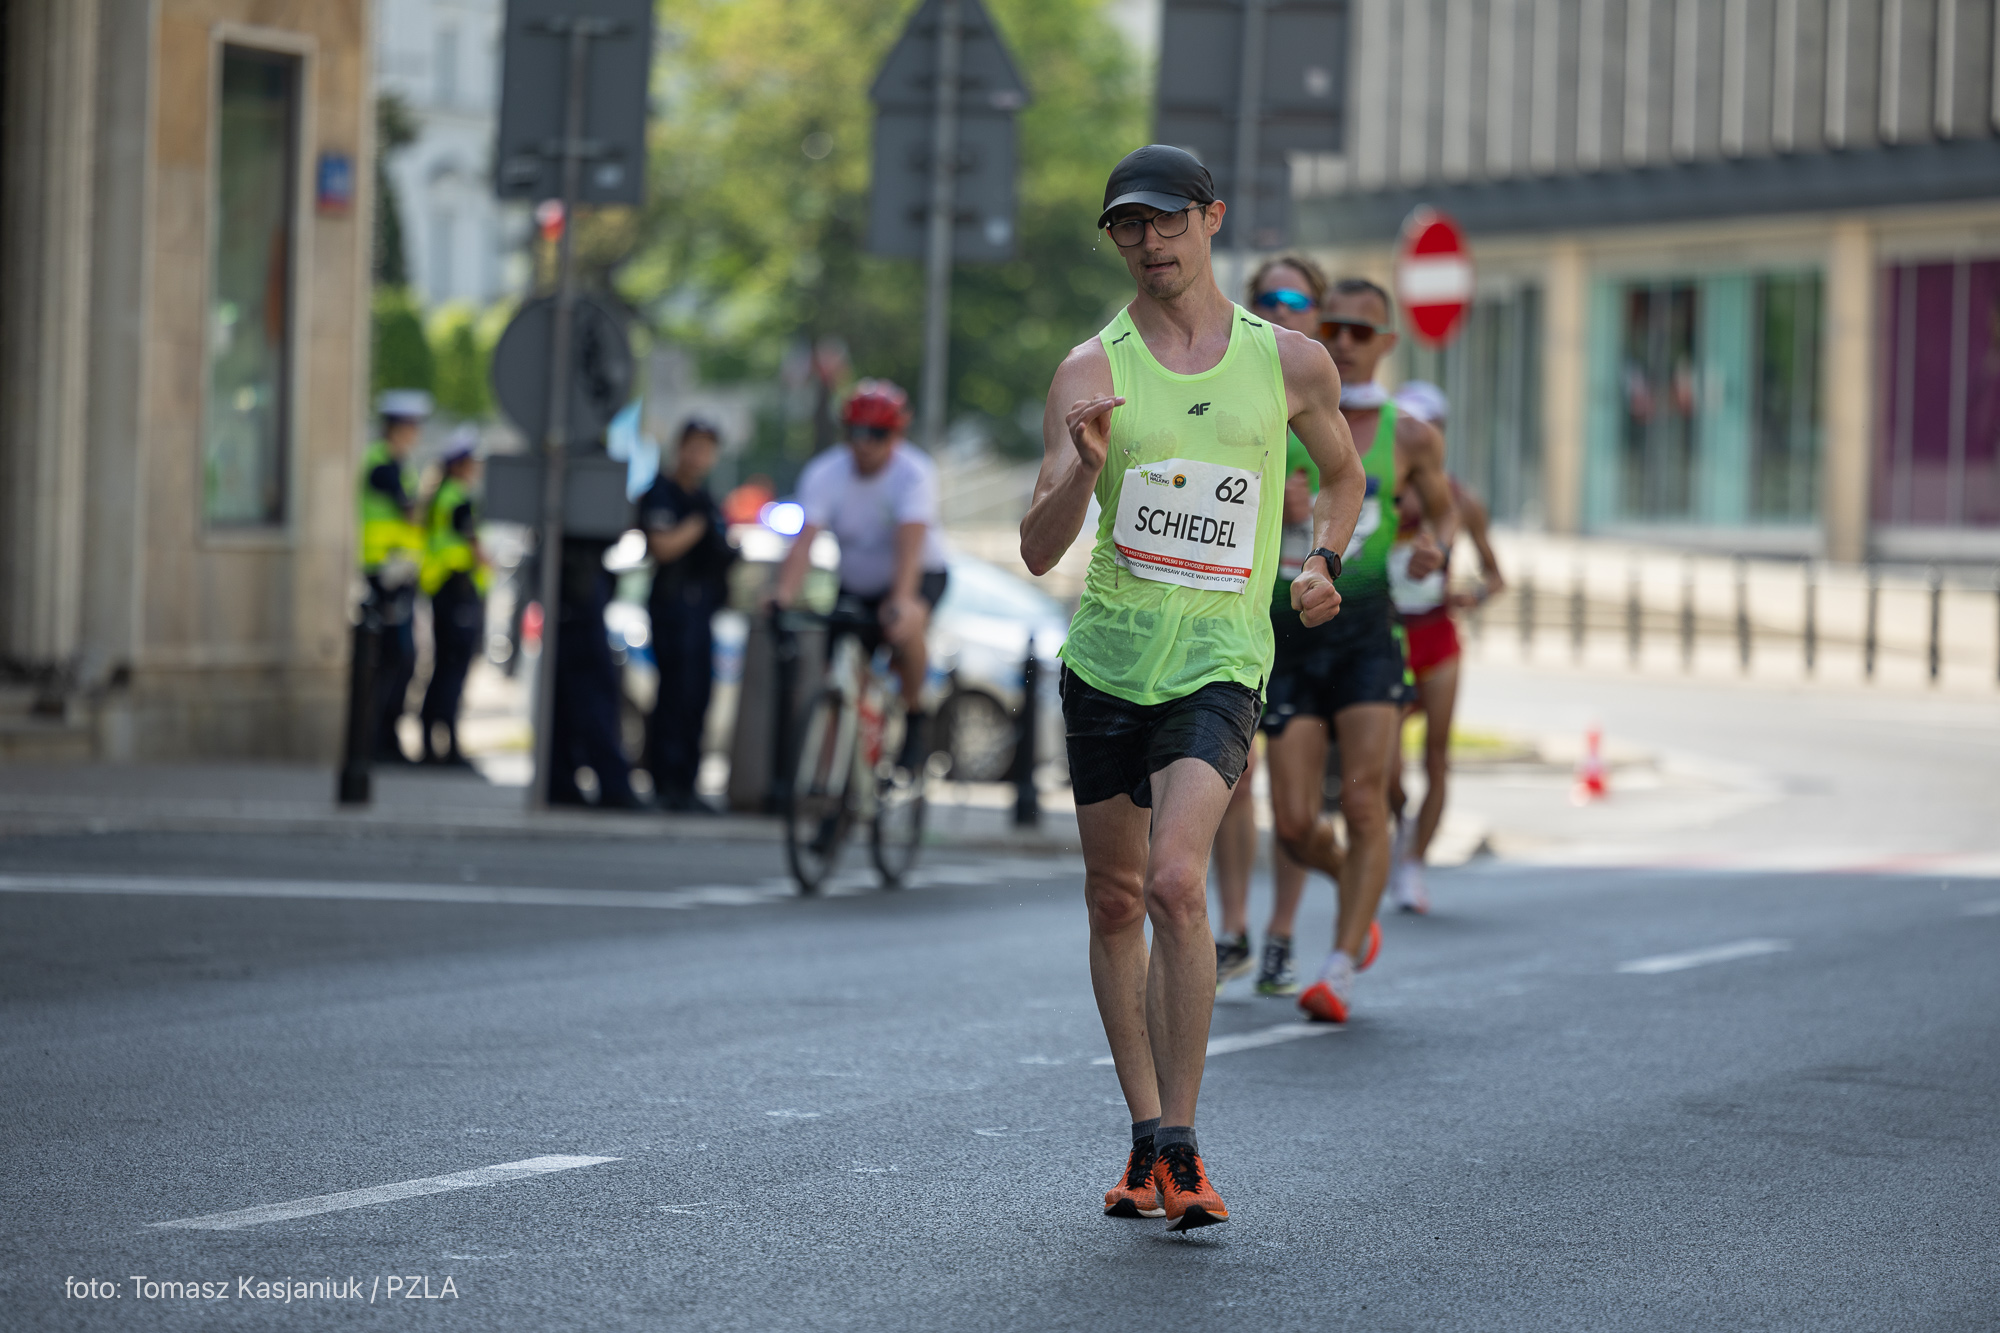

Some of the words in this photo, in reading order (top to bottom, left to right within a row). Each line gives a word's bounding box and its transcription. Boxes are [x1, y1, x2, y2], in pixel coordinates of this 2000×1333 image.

[1187, 402, 1211, 416] 4F
[1150, 476, 1170, 485] WALKING
[1215, 477, 1248, 504] 62
[1134, 506, 1236, 548] SCHIEDEL
[1128, 549, 1161, 562] MISTRZOSTWA
[1161, 557, 1178, 566] POLSKI
[1184, 561, 1205, 570] CHODZIE
[1204, 565, 1233, 573] SPORTOWYM
[1154, 565, 1181, 575] WARSAW
[1180, 570, 1195, 579] RACE
[1195, 573, 1220, 582] WALKING
[1233, 577, 1246, 585] 2024
